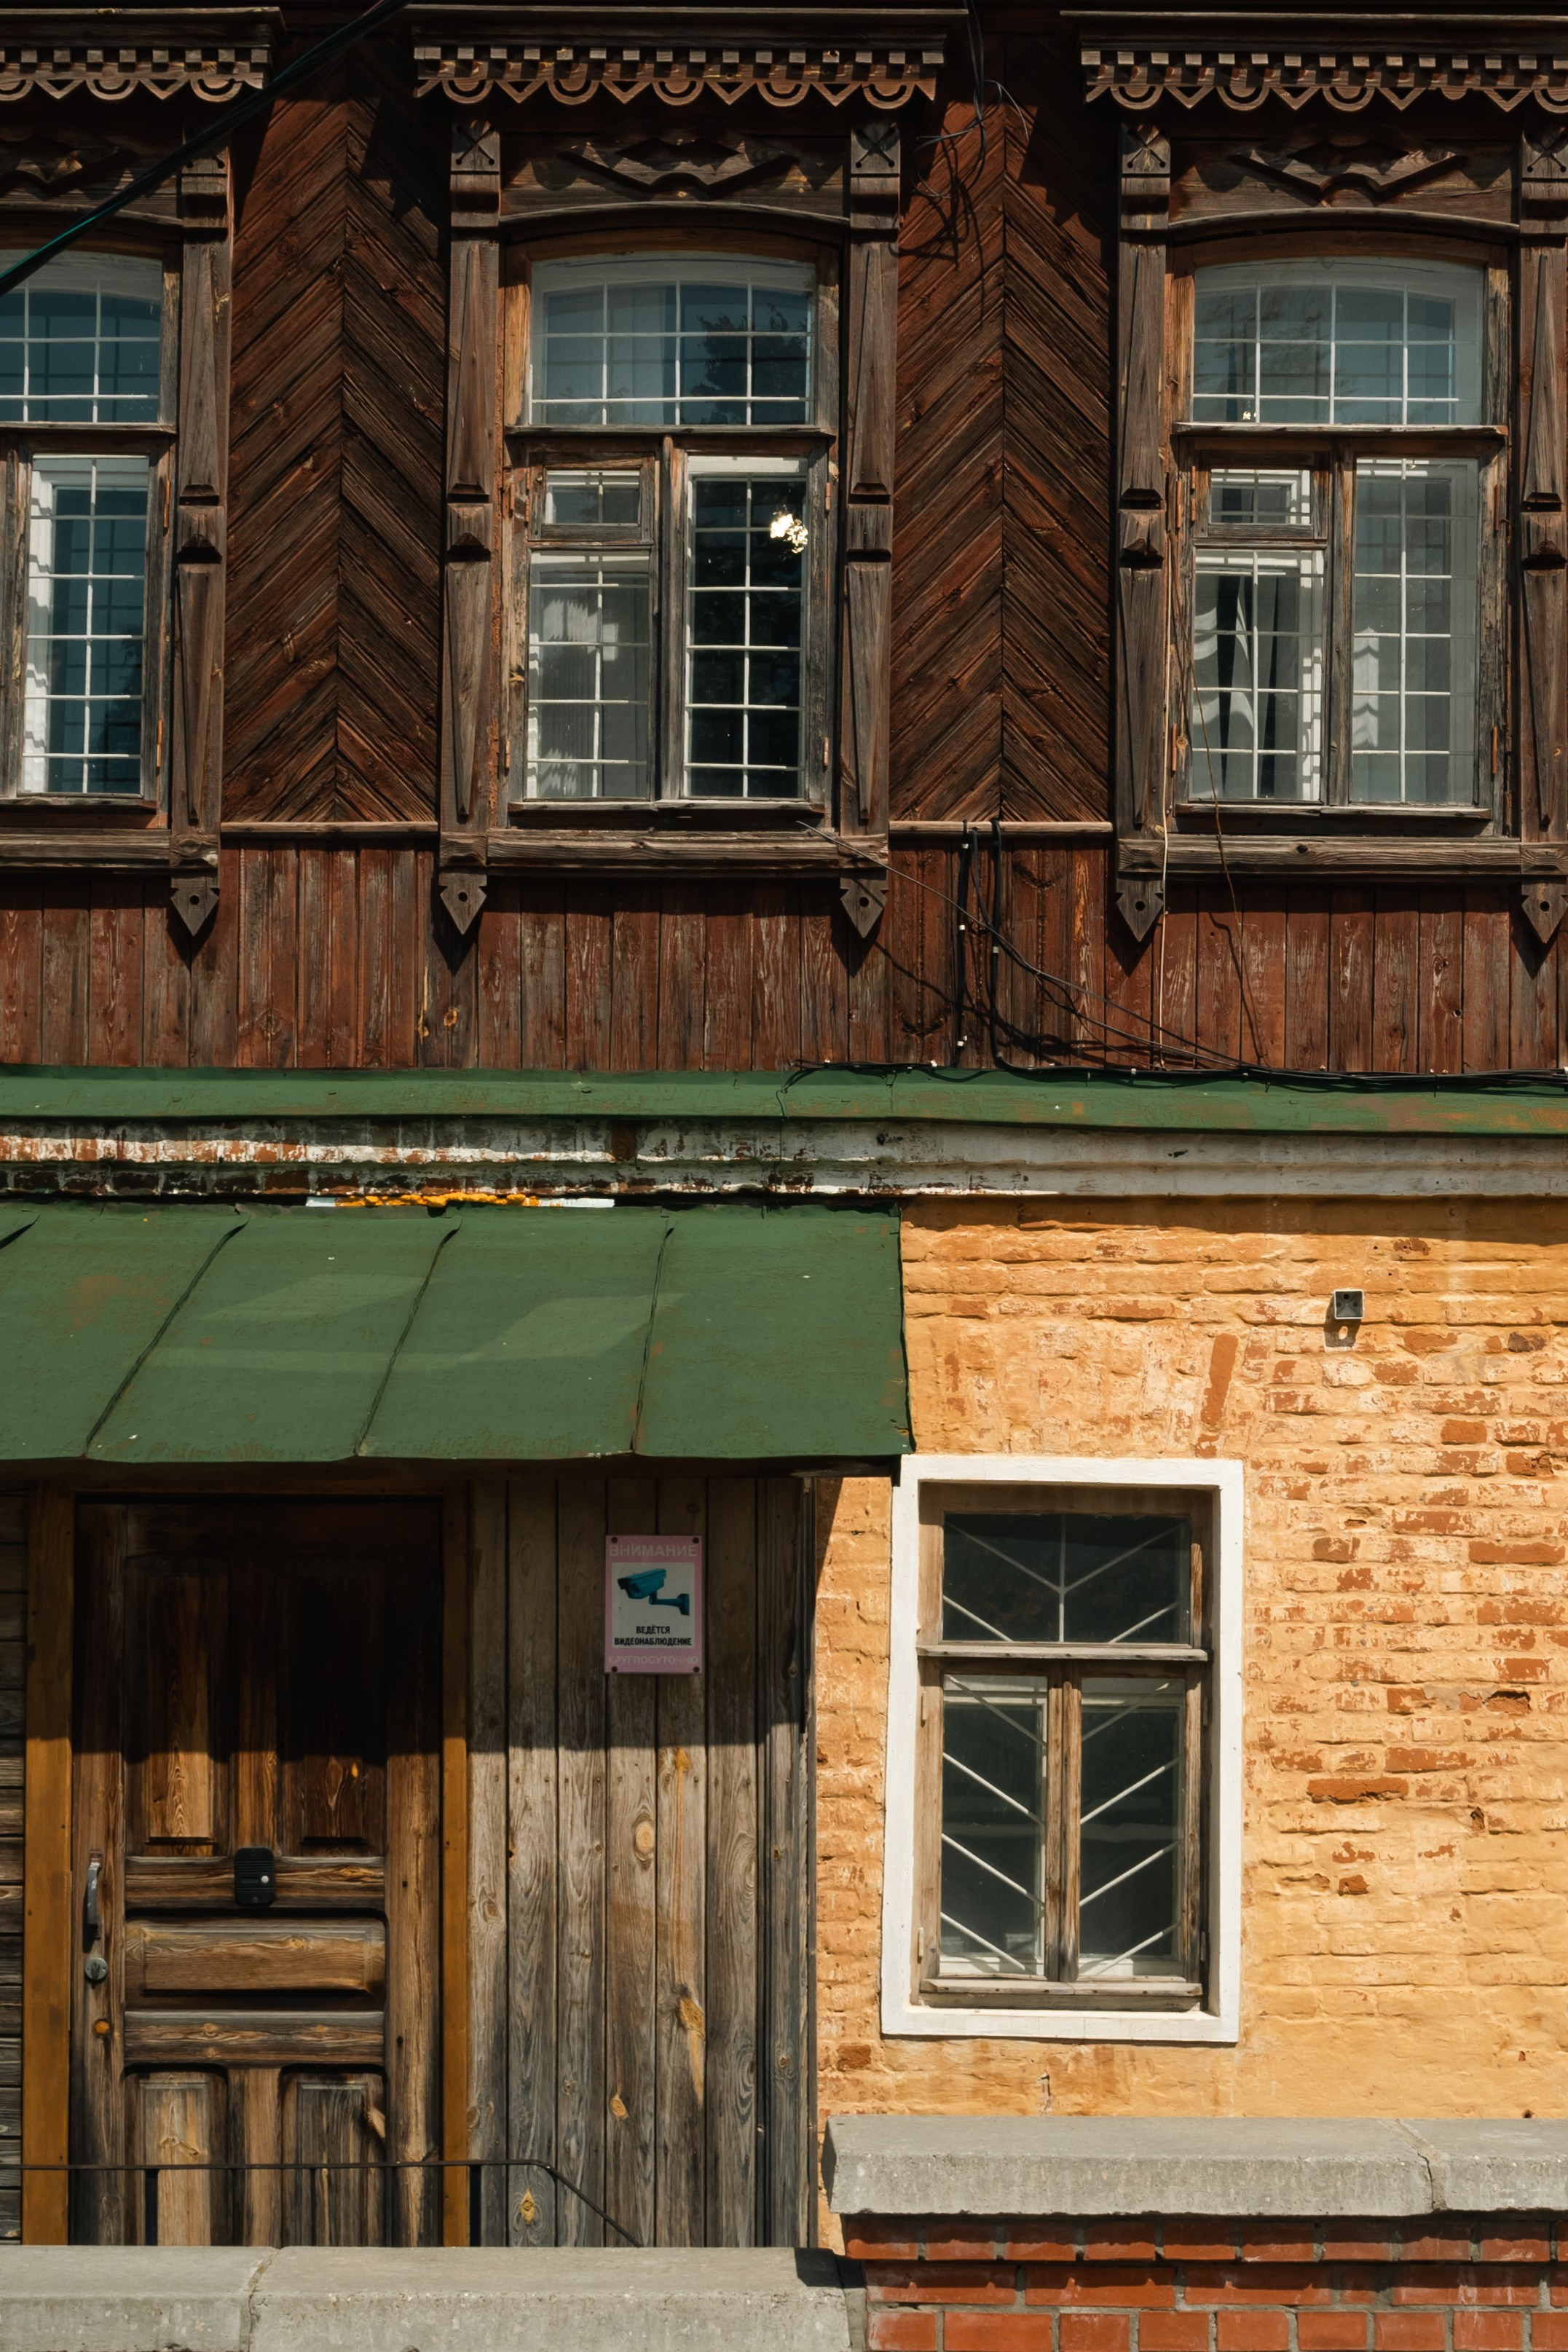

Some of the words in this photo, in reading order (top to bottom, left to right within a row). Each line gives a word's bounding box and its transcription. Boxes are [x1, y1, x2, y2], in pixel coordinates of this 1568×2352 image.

[609, 1544, 697, 1557] ВНИМАНИЕ
[636, 1624, 670, 1635] ВЕДЁТСЯ
[614, 1637, 692, 1646] ВИДЕОНАБЛЮДЕНИЕ
[608, 1656, 699, 1665] КРУГЛОСУТОЧНО
